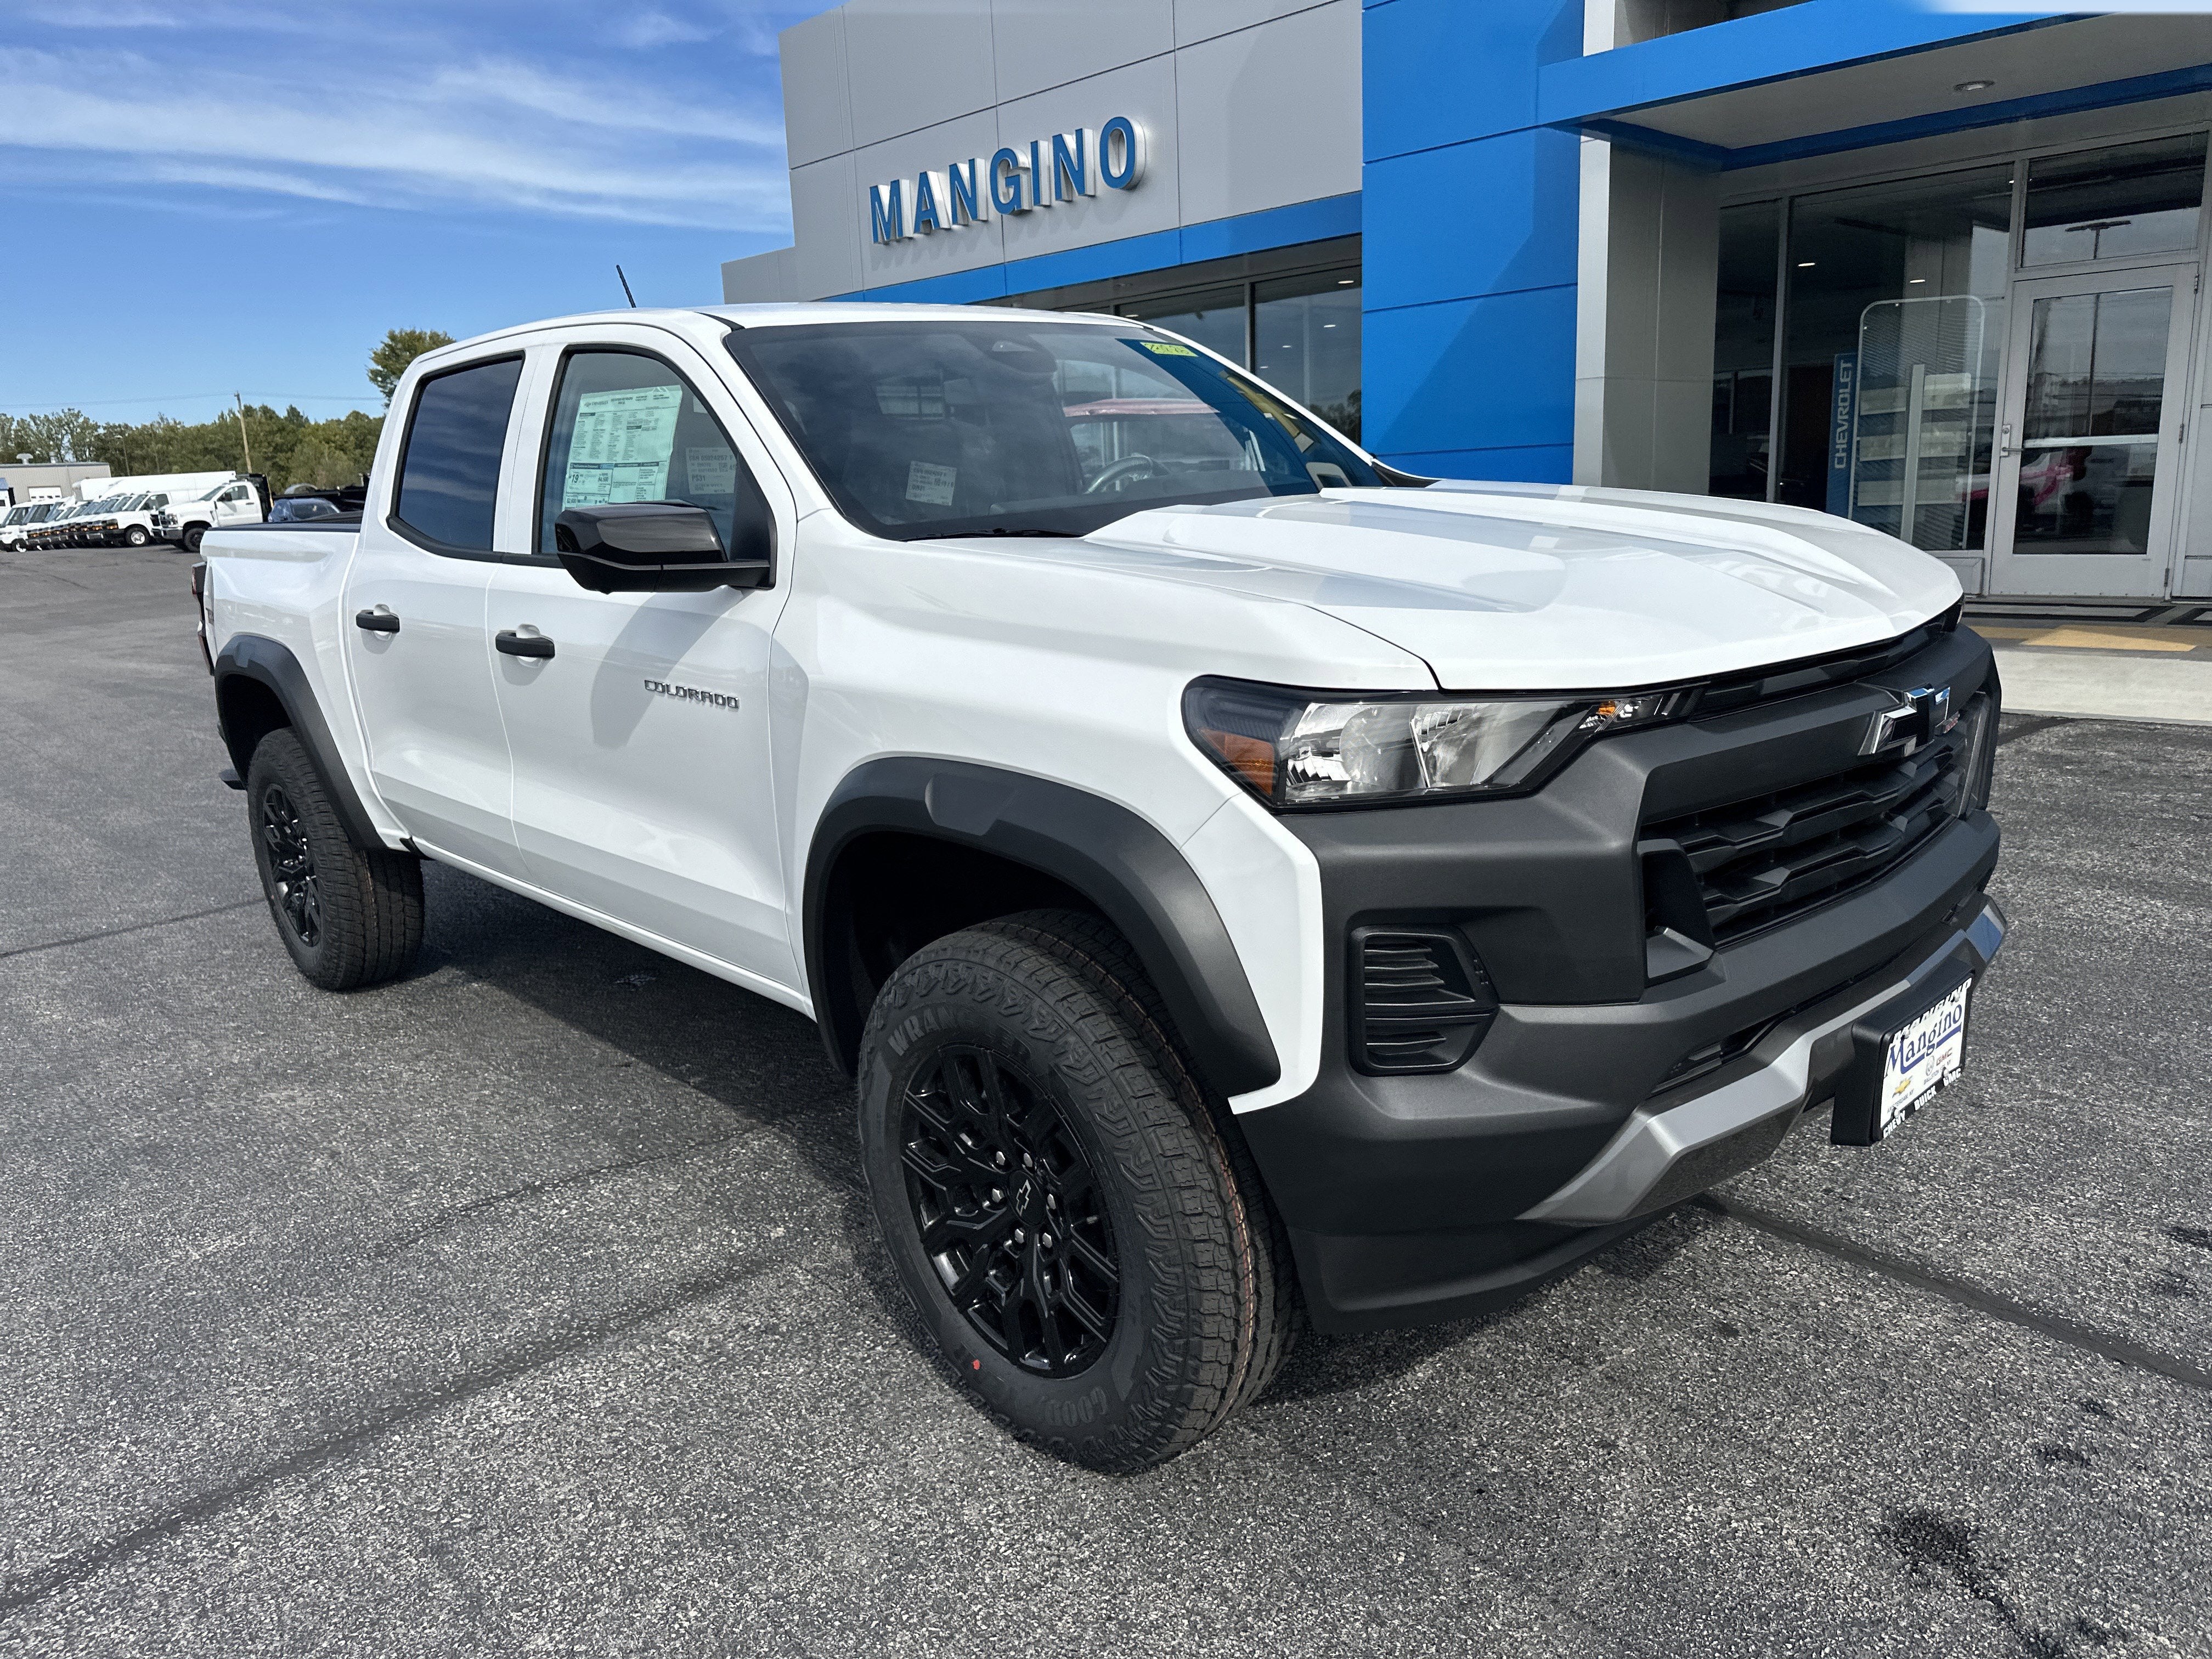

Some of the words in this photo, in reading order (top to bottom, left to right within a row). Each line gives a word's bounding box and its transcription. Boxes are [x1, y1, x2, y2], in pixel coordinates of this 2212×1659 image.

[870, 116, 1144, 244] MANGINO
[1834, 359, 1853, 470] CHEVROLET
[644, 679, 740, 709] COLORADO
[1884, 1005, 1962, 1076] Mangino
[1892, 978, 1972, 1041] MANGINO
[1936, 1047, 1953, 1066] GMC
[1883, 1110, 1906, 1138] CHEVY
[1914, 1085, 1937, 1111] BUICK
[1943, 1068, 1962, 1087] GMC
